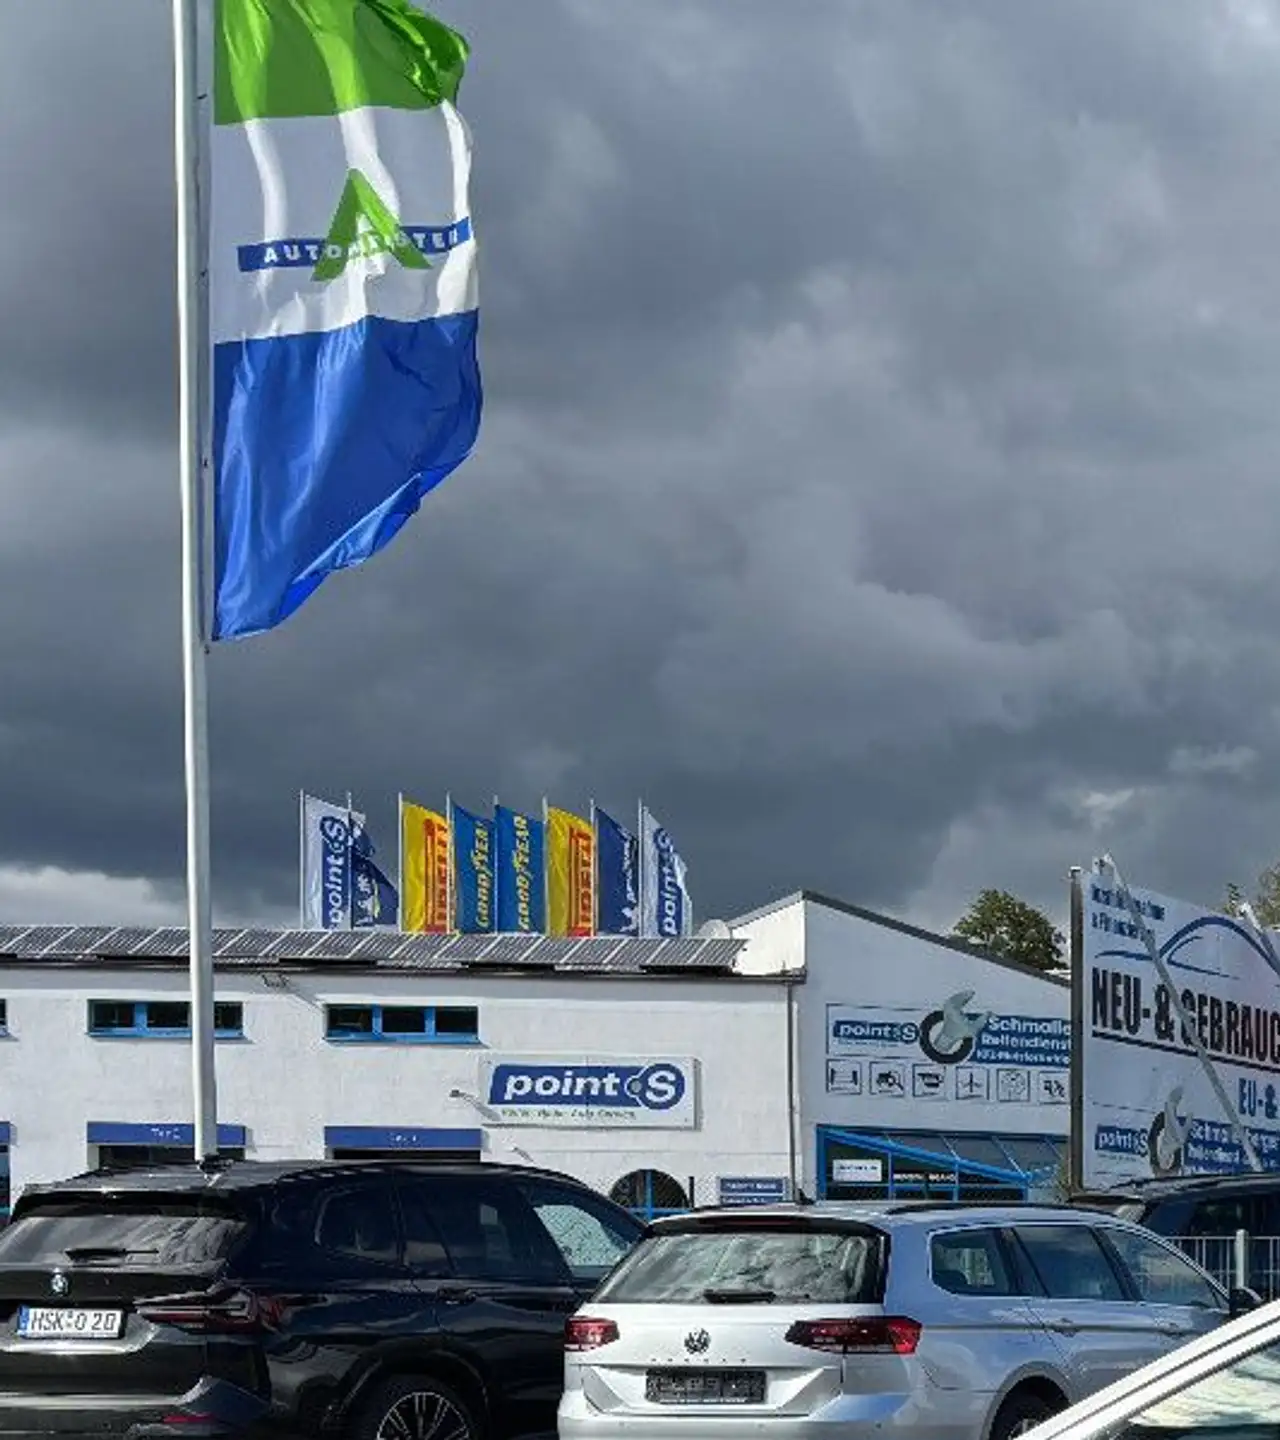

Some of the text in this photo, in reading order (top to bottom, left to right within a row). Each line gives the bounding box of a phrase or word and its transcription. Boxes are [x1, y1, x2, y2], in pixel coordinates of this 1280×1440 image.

[1092, 967, 1150, 1035] NEU-
[503, 1069, 676, 1103] point S
[31, 1310, 64, 1331] HSK
